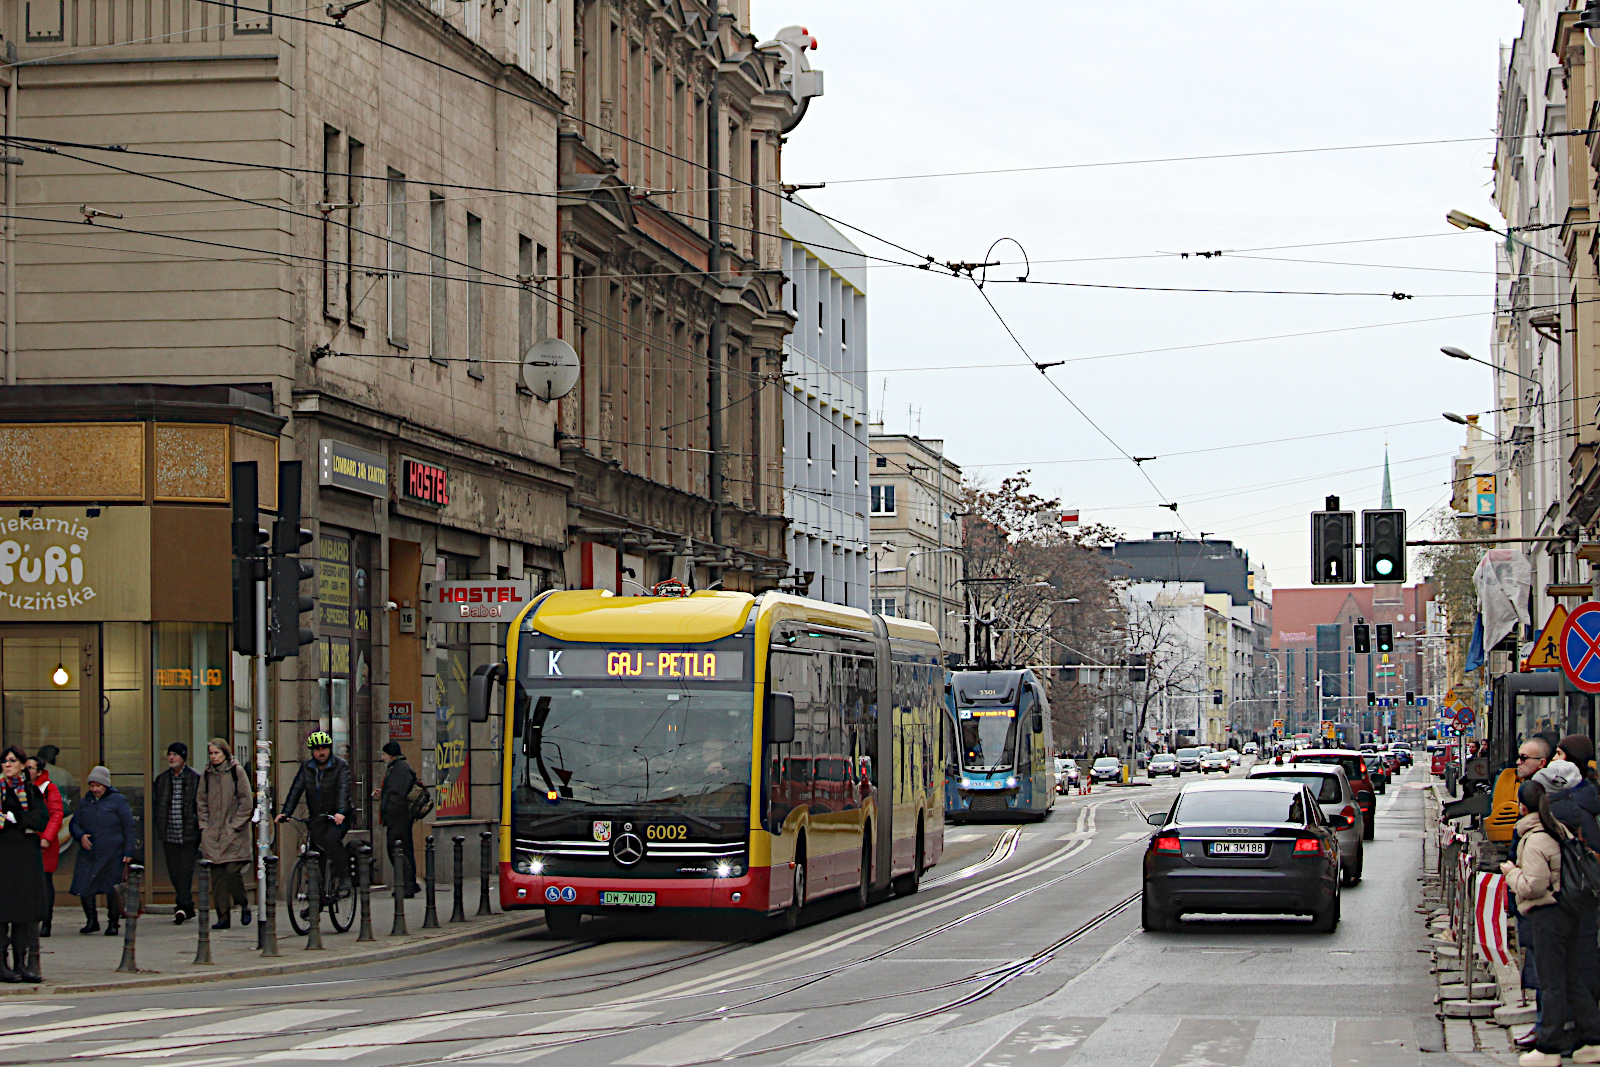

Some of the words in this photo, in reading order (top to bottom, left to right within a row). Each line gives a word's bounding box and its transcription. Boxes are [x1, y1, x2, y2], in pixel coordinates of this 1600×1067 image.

[333, 455, 357, 477] LOMBARD
[367, 465, 387, 485] KANTOR
[410, 460, 450, 505] HOSTEL
[439, 586, 523, 603] HOSTEL
[402, 614, 412, 623] 16
[460, 604, 502, 618] Babel
[355, 609, 368, 631] 24h
[548, 650, 563, 676] K
[607, 651, 643, 676] GAJ
[646, 824, 687, 840] 6002
[1215, 843, 1230, 853] DW
[606, 893, 619, 903] DW
[622, 893, 653, 904] 7WU02
